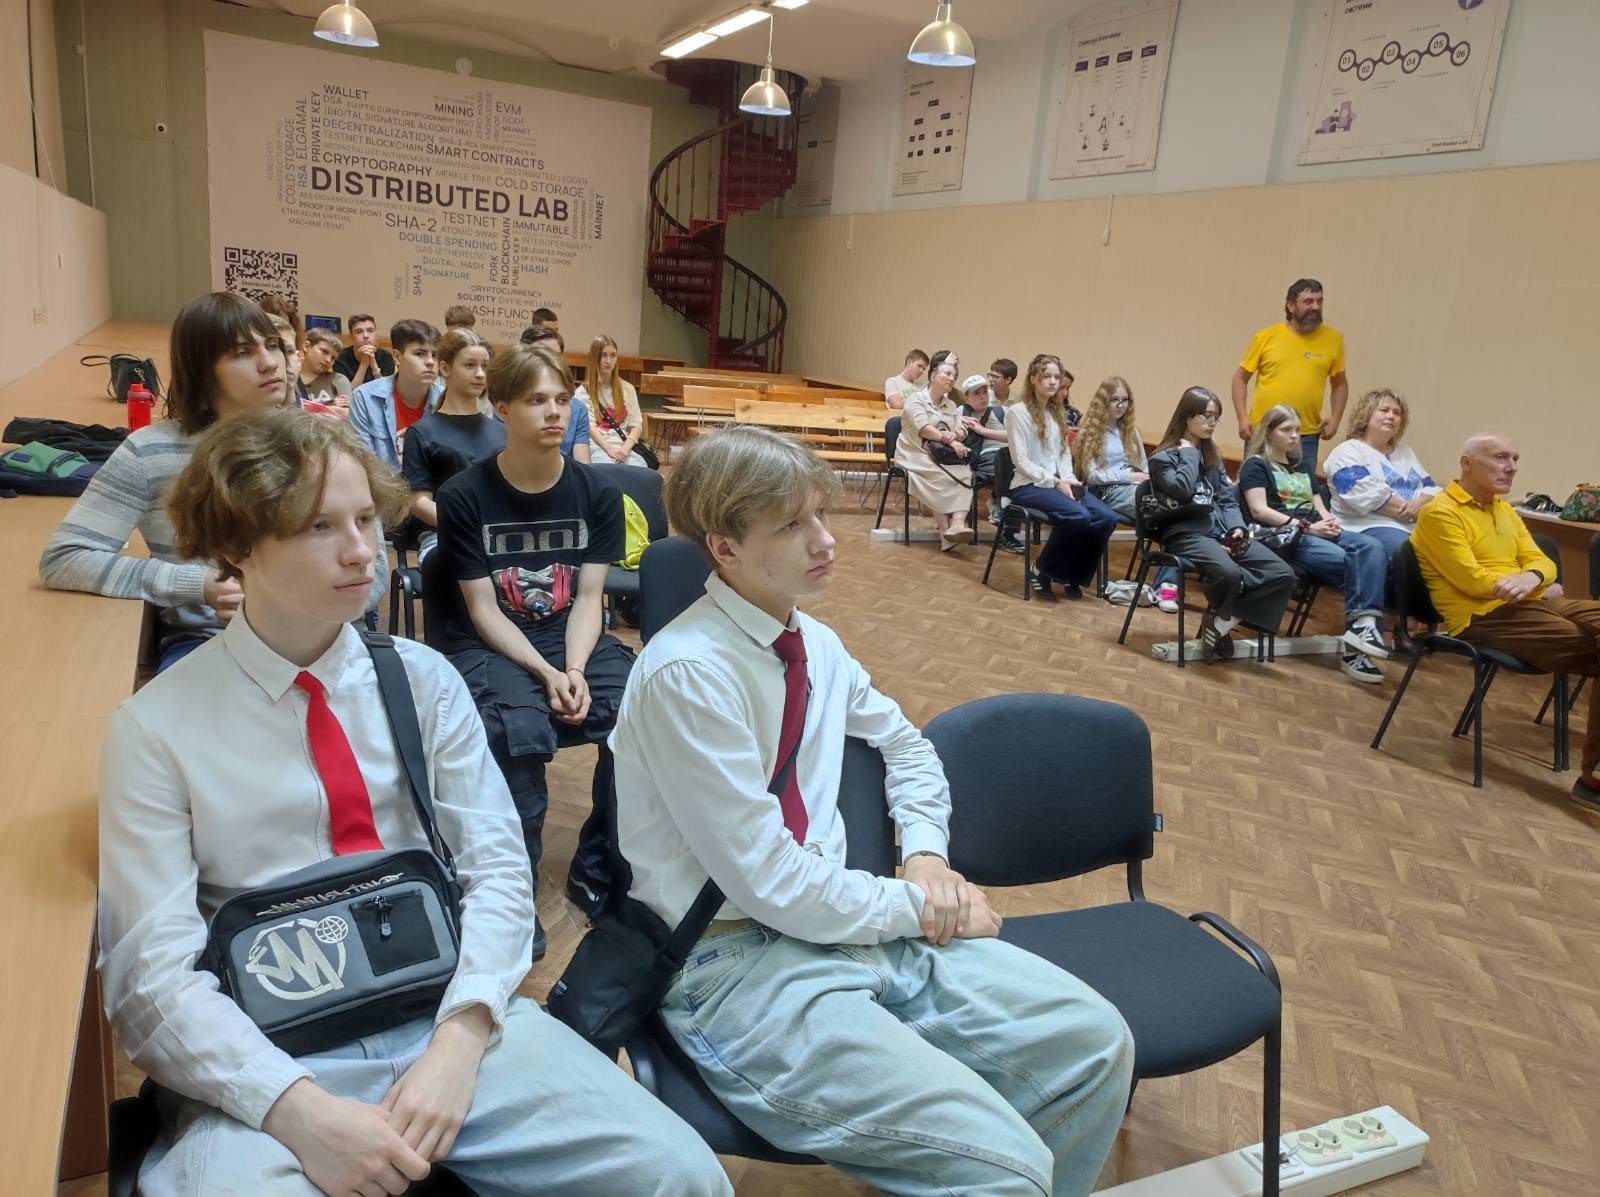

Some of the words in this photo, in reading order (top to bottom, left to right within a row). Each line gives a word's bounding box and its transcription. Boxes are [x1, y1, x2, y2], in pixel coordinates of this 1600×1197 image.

[1432, 40, 1443, 49] 05
[1342, 56, 1351, 65] 01
[1386, 49, 1395, 57] 03
[1456, 49, 1466, 58] 06
[1361, 65, 1370, 73] 02
[1406, 57, 1416, 66] 04
[323, 84, 369, 100] WALLET
[323, 95, 342, 104] DSA
[311, 91, 321, 113] KEY
[496, 101, 522, 116] EVM
[435, 103, 475, 118] MINING
[296, 96, 307, 160] ELGAMAL
[324, 106, 363, 119] (DIGITAL
[365, 112, 416, 129] SIGNATURE
[418, 122, 473, 137] ALGORITHM)
[323, 117, 435, 144] DECENTRALIZATION
[323, 130, 363, 143] TESTNET
[502, 125, 531, 136] MAINNET
[284, 117, 295, 171] STORAGE
[311, 115, 321, 163] PRIVATE
[365, 136, 424, 152] BLOCKCHAIN
[323, 150, 433, 178] CRYPTOGRAPHY
[426, 142, 471, 160] SMART
[471, 150, 545, 171] CONTRACTS
[297, 165, 307, 188] RSA
[471, 173, 492, 184] TREE
[285, 173, 296, 204] COLD
[311, 165, 511, 214] DISTRIBUTED
[519, 193, 569, 222] LAB
[494, 176, 529, 191] COLD
[531, 180, 585, 198] STORAGE
[385, 212, 437, 232] SHA-2
[441, 211, 497, 229] TESTNET
[594, 192, 604, 240] MAINNET
[440, 226, 472, 237] ATOMIC
[474, 229, 499, 239] SWAP
[512, 220, 570, 236] IMMUTABLE
[399, 231, 442, 245] DOUBLE
[444, 237, 498, 251] SPENDING
[501, 217, 512, 285] BLOCKCHAIN
[423, 257, 457, 268] DIGITAL
[460, 261, 484, 271] HASH
[490, 254, 499, 282] FORK
[520, 264, 550, 274] HASH
[423, 269, 471, 281] SIGNATURE
[512, 256, 520, 287] PUBLIC
[412, 264, 422, 297] SHA-3
[457, 292, 497, 302] SOLIDITY
[470, 284, 543, 298] CRYPTOCURRENCY
